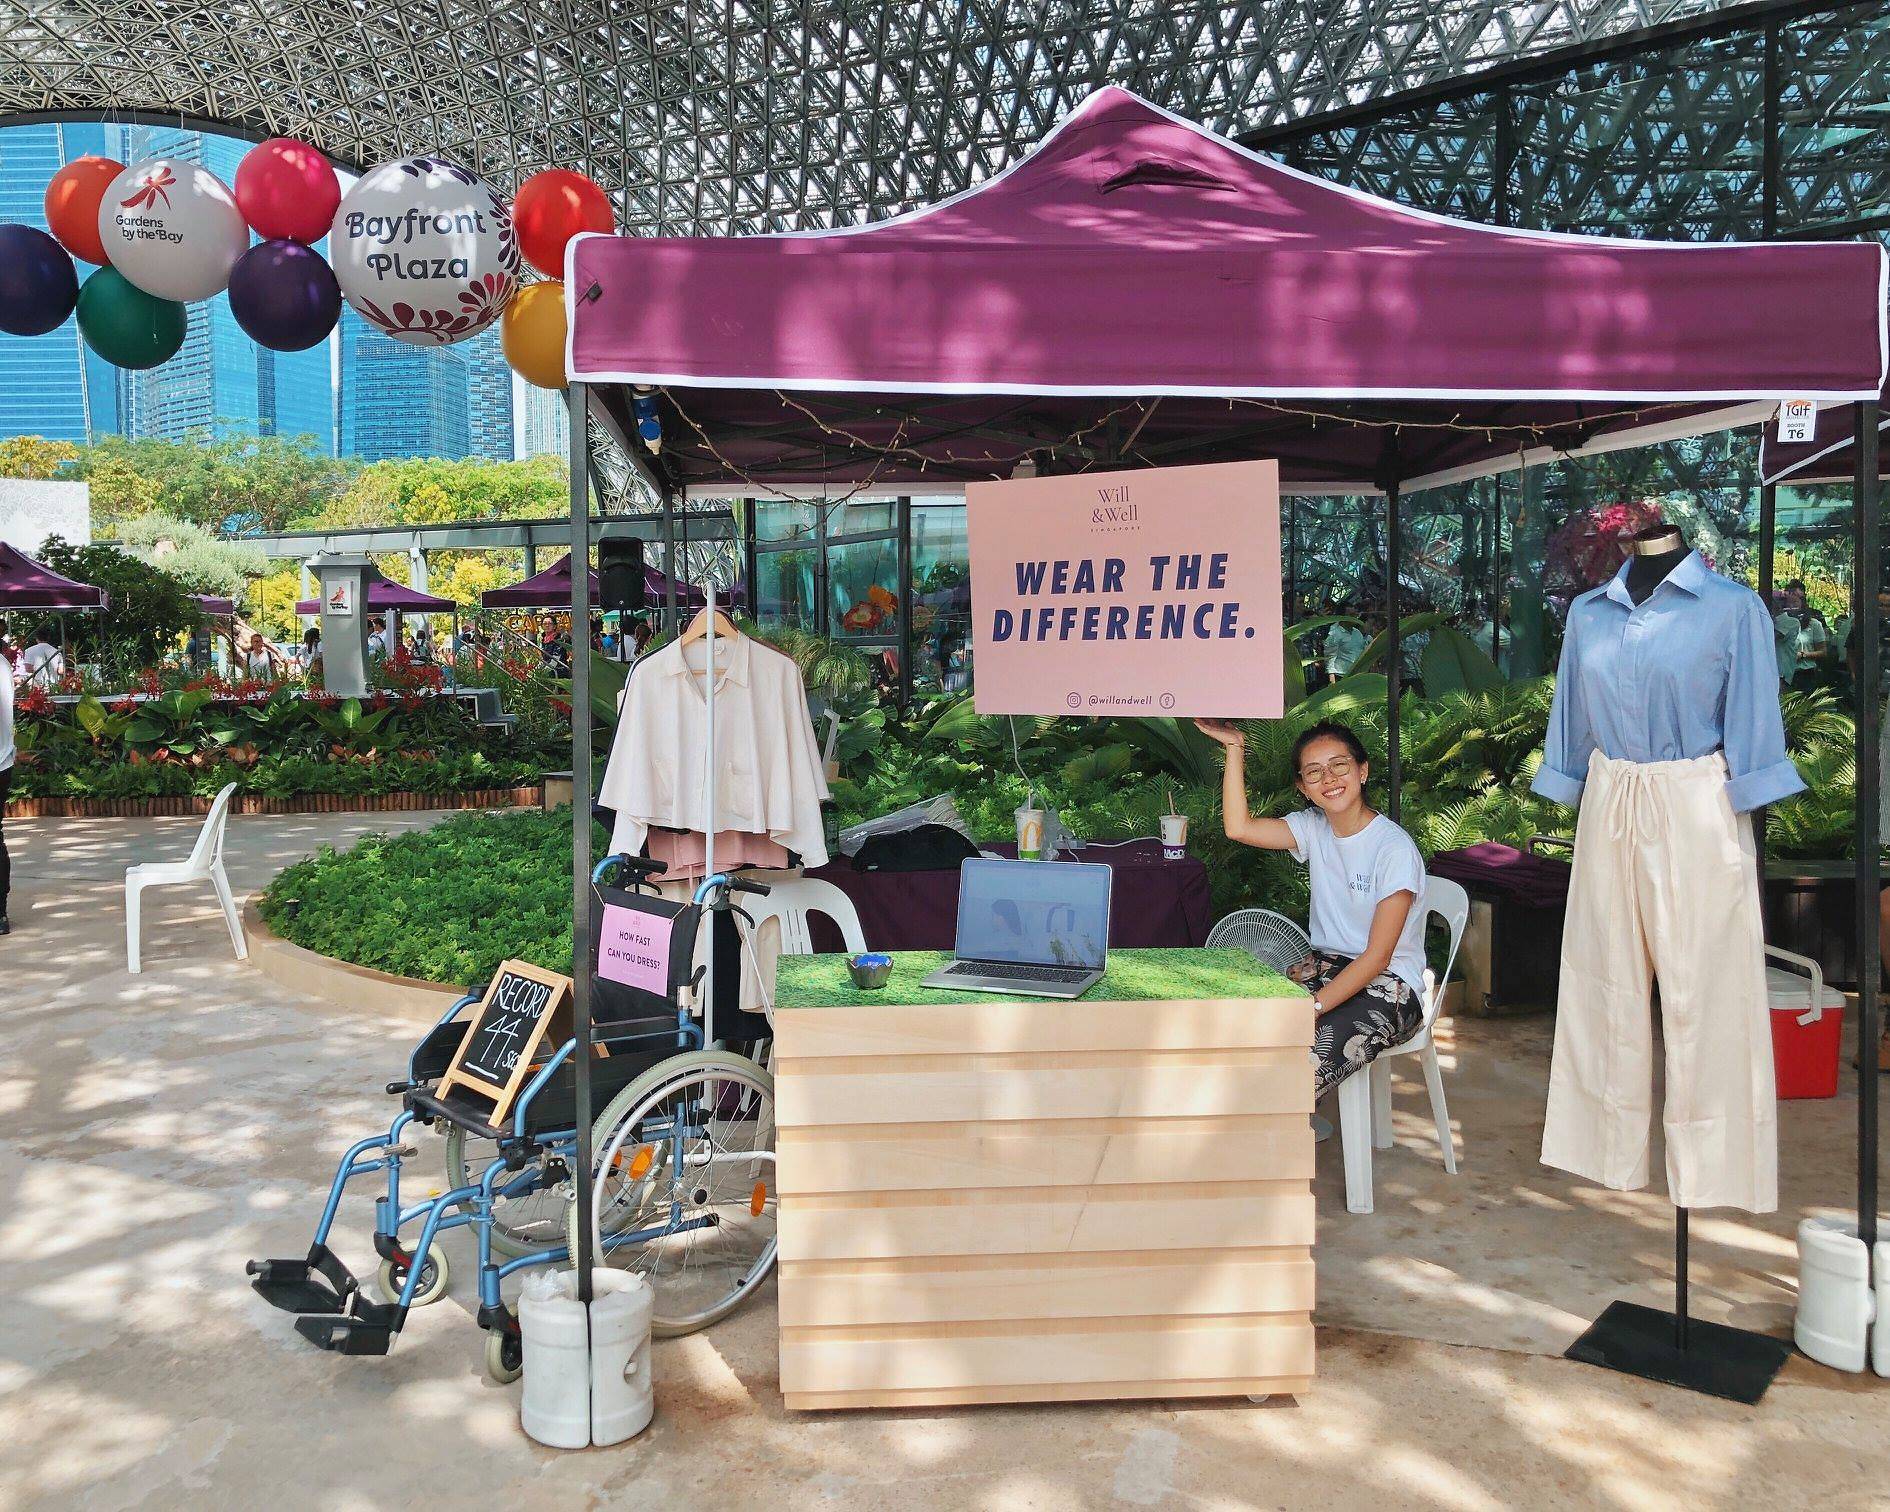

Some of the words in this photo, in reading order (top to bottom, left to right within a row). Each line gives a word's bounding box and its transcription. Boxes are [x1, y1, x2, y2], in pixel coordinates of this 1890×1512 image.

[115, 214, 164, 228] Gardens
[345, 208, 487, 245] Bayfront
[122, 227, 135, 241] by
[137, 228, 156, 240] the
[156, 229, 184, 244] Bay
[366, 252, 468, 281] Plaza
[1788, 429, 1804, 439] T6
[1098, 485, 1129, 503] Will
[1015, 558, 1126, 596] WEAR
[1150, 553, 1228, 591] THE
[992, 602, 1255, 642] DIFFERENCE.
[1088, 694, 1152, 706] @willandwell
[619, 931, 634, 943] HOW
[635, 935, 651, 947] FAST
[607, 948, 621, 959] CAN
[622, 952, 636, 963] YOU
[637, 956, 660, 970] DRESS?
[492, 974, 551, 1018] RECORD
[480, 1014, 522, 1068] 44
